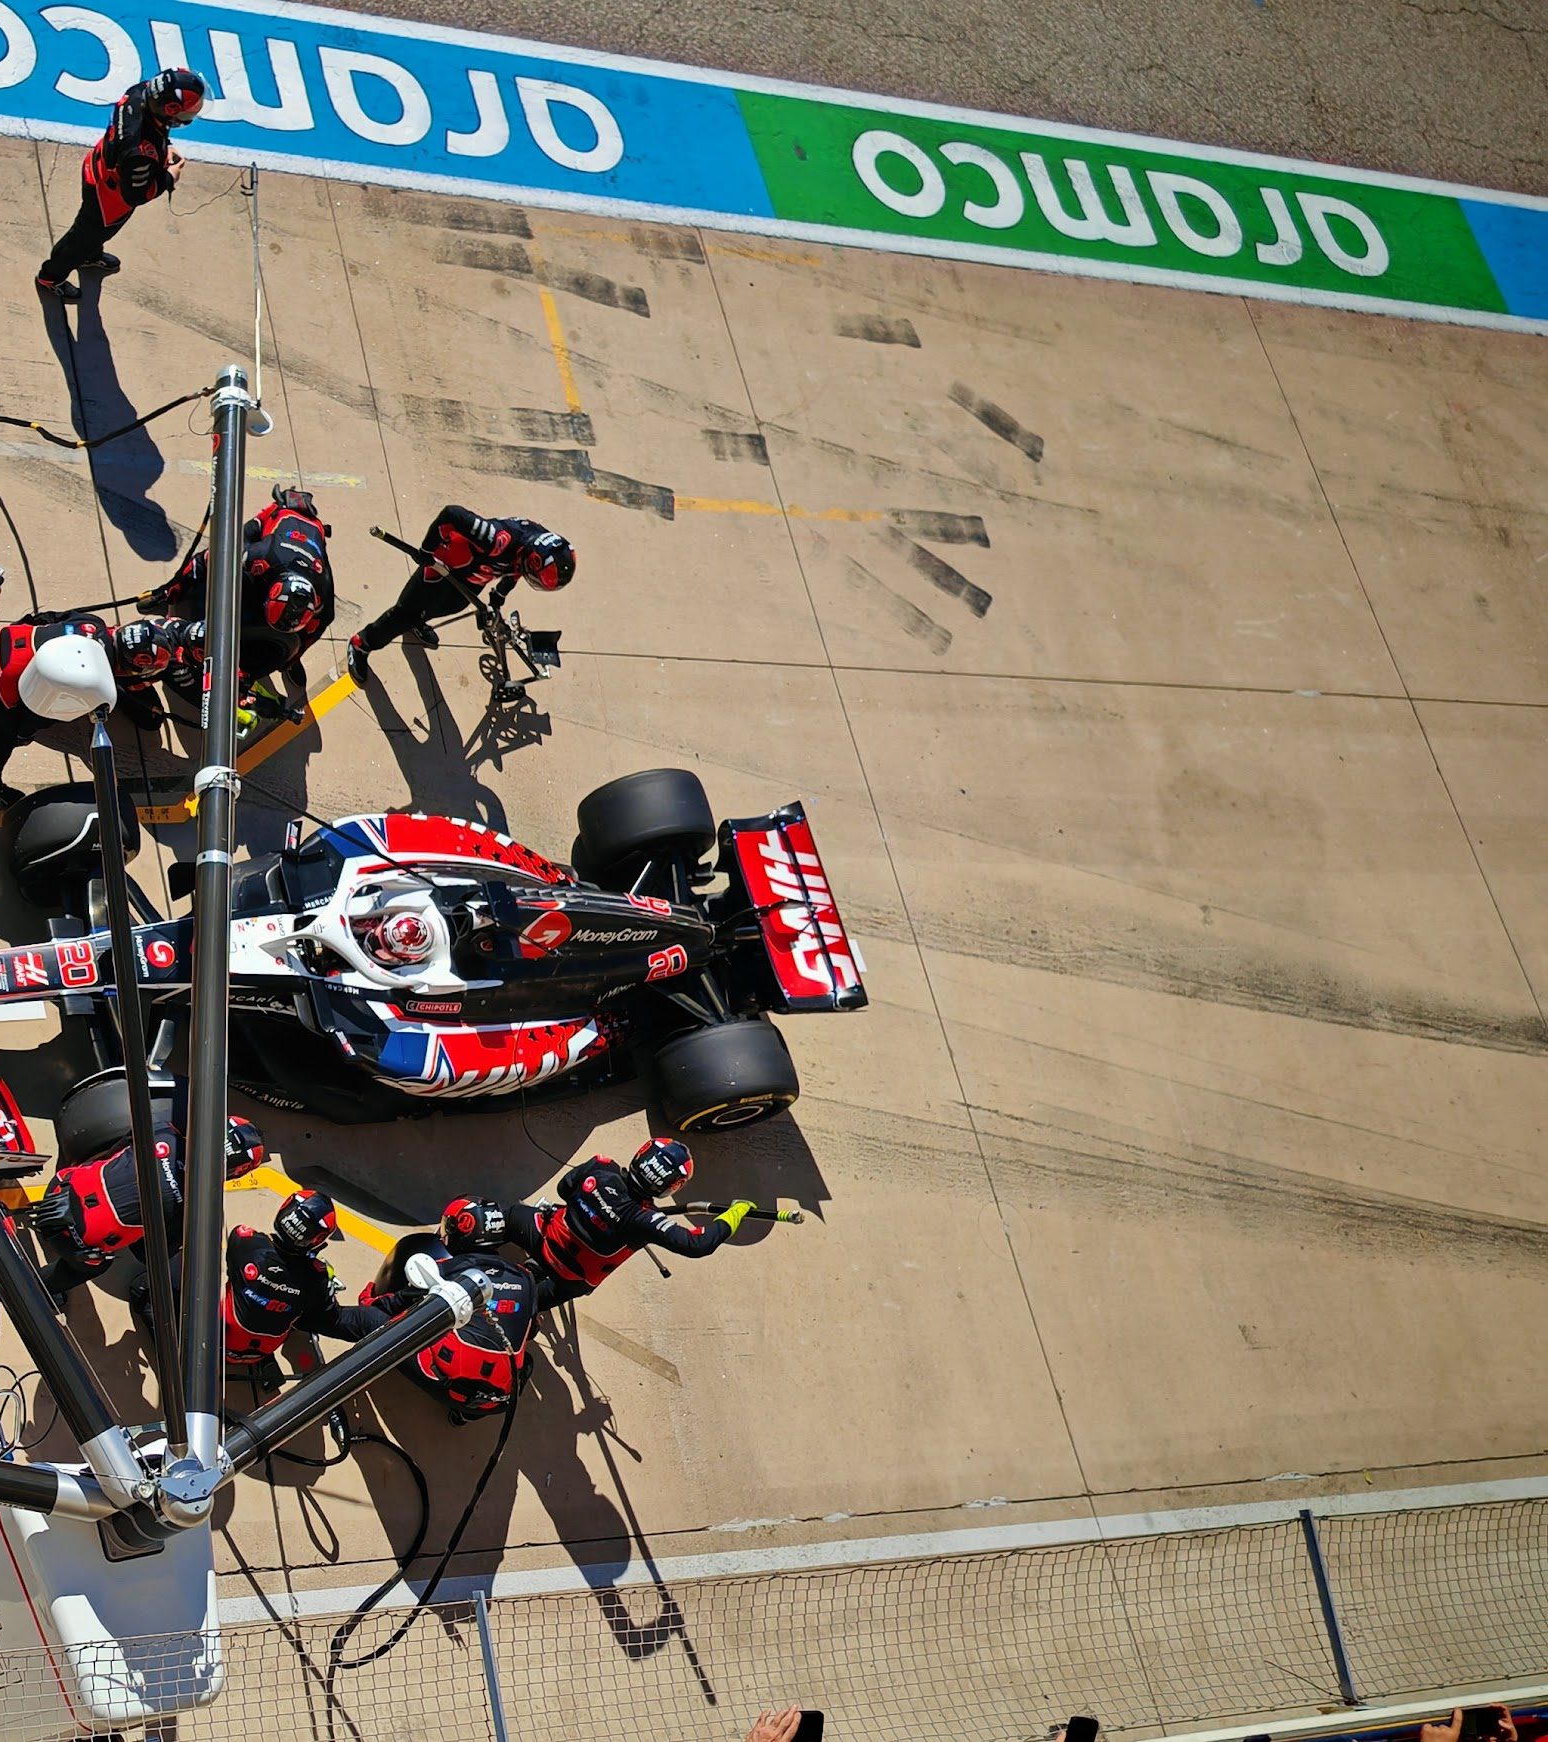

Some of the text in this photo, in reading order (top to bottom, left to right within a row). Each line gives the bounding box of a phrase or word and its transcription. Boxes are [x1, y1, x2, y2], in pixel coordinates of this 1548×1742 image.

[852, 129, 1390, 278] aramco
[758, 829, 860, 991] HAAS
[570, 928, 658, 944] MoneyGram
[54, 940, 98, 988] 20
[134, 936, 149, 978] MoneyGram
[644, 944, 688, 982] 20
[420, 1004, 459, 1012] CHIPOTLE
[639, 1162, 664, 1185] Angels
[650, 1156, 671, 1175] Palm
[161, 1157, 184, 1204] MoneyGram
[232, 1180, 241, 1188] 20
[281, 1216, 304, 1241] Angels
[289, 1212, 307, 1232] Palm
[256, 1274, 301, 1296] MoneyGram
[498, 1299, 516, 1312] GO
